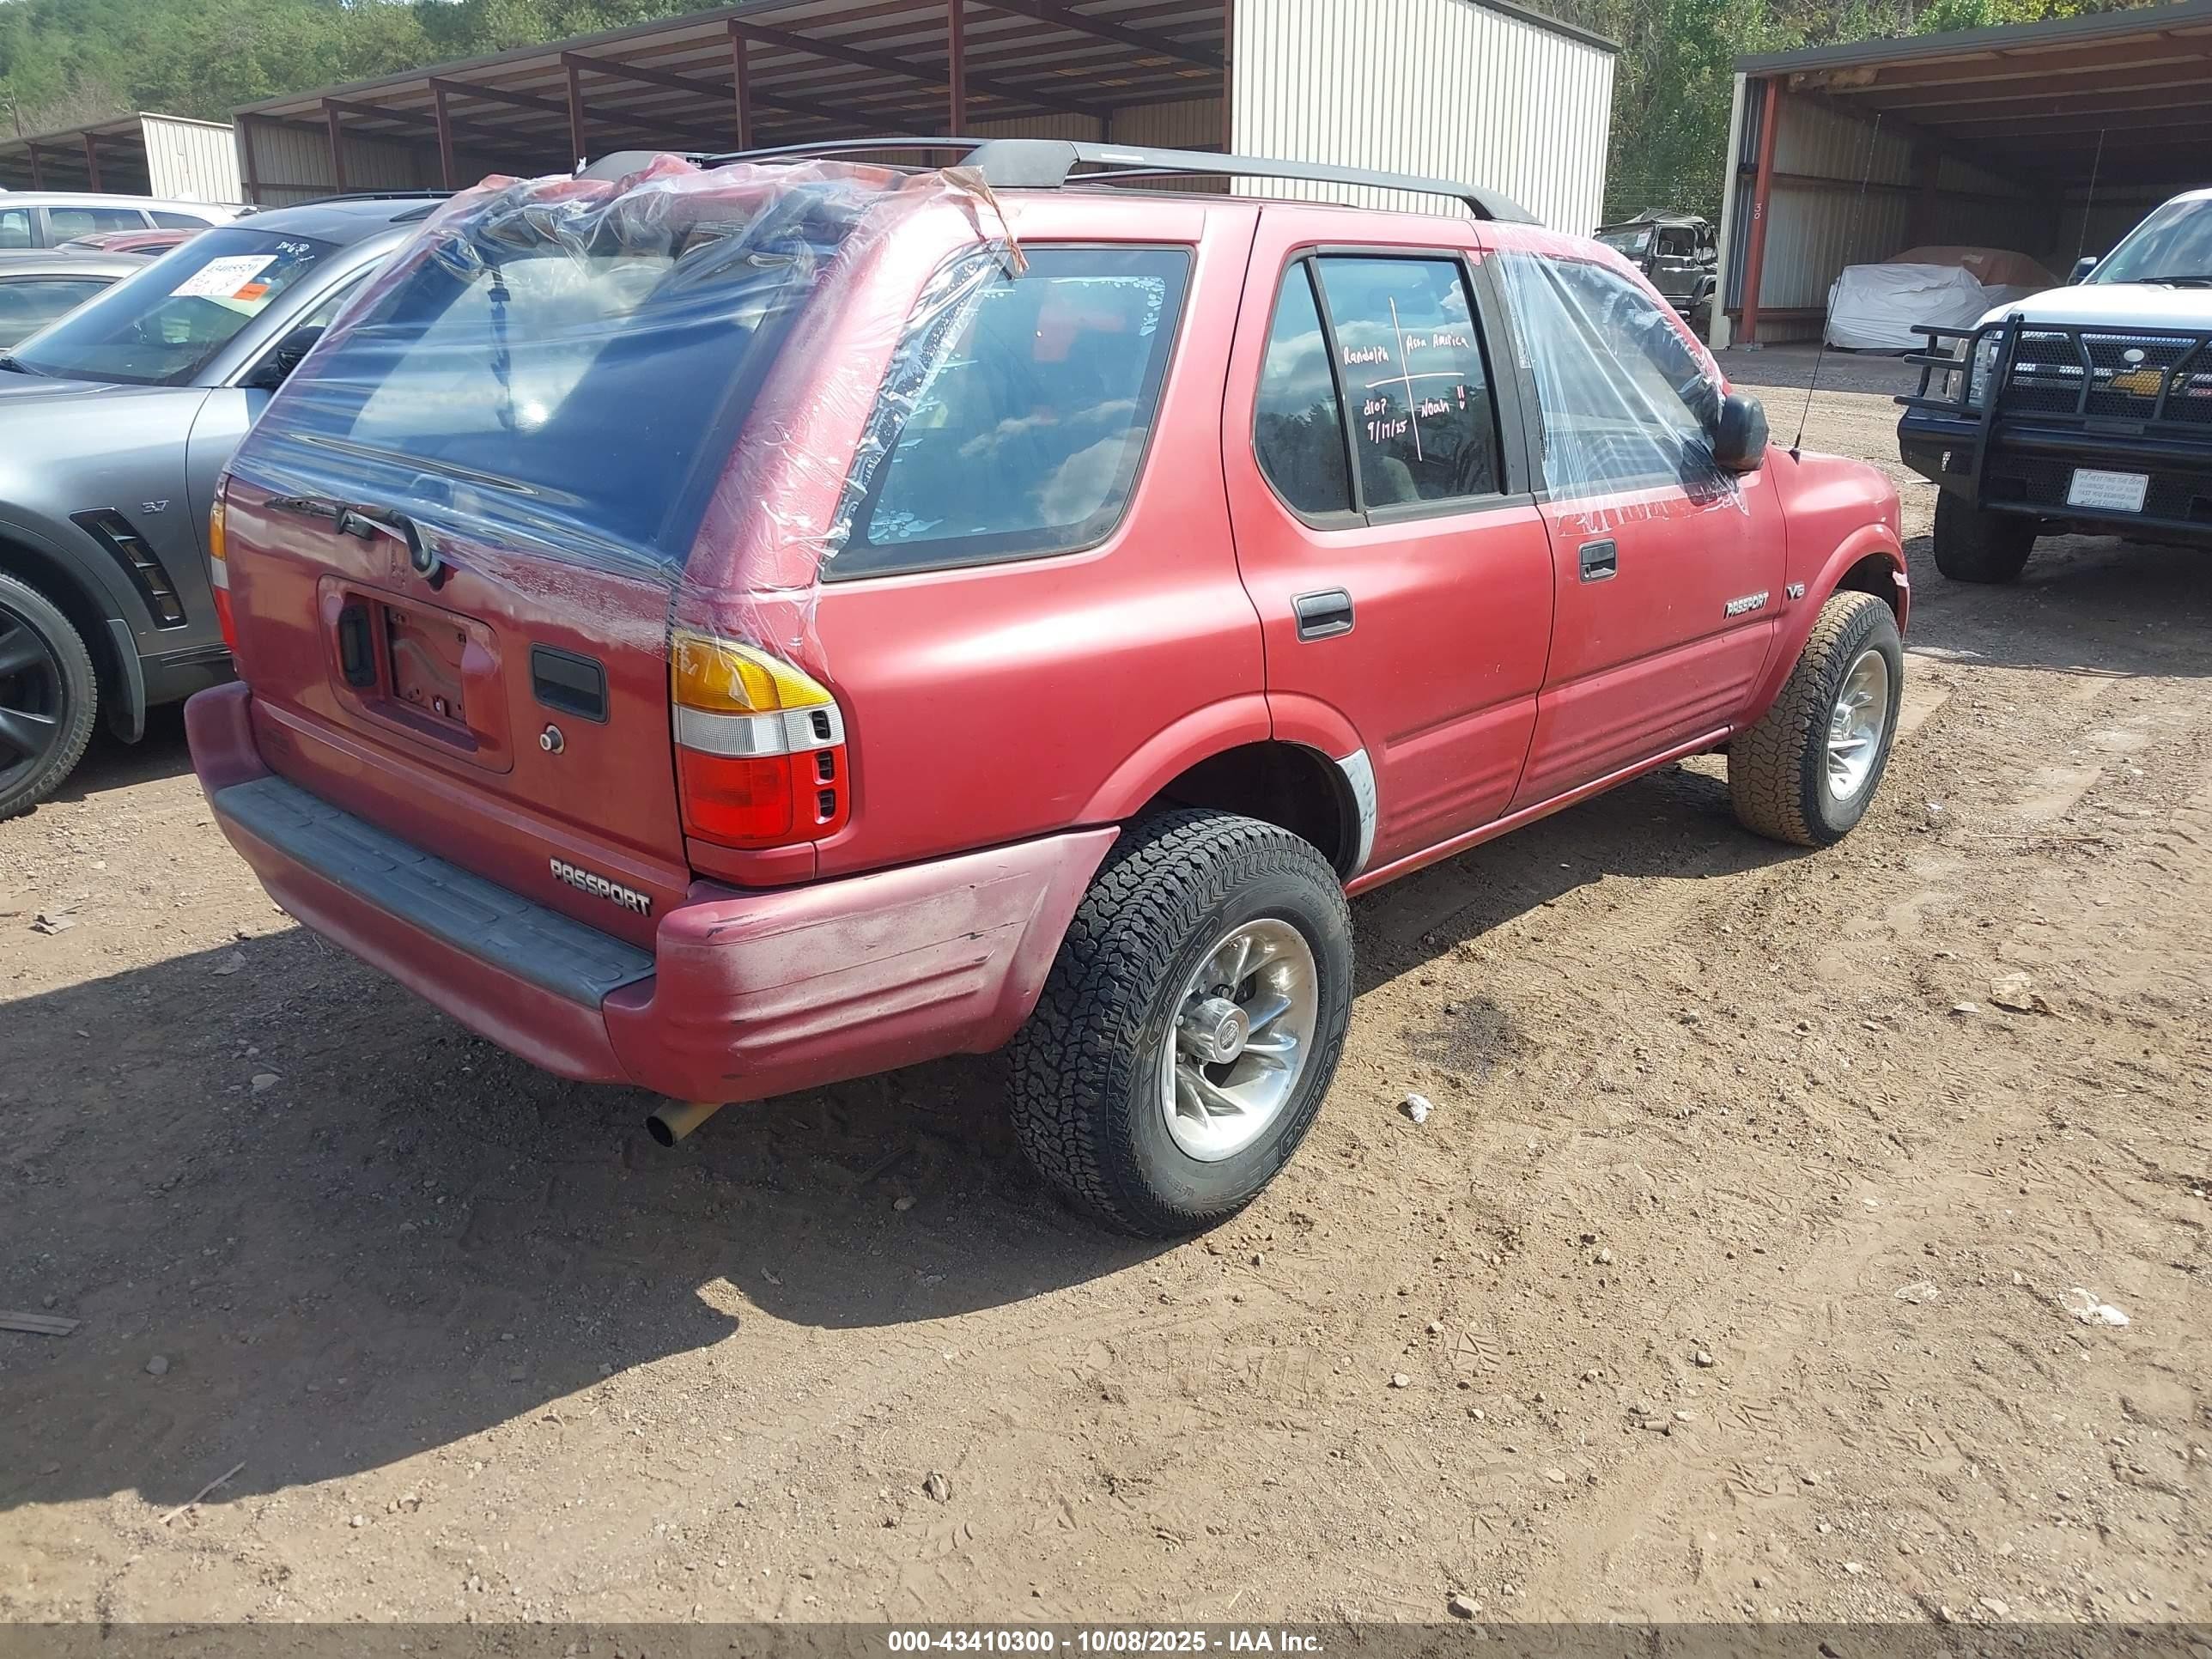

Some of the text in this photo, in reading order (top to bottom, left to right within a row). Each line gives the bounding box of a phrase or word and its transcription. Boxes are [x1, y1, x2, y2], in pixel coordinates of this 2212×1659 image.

[1421, 398, 1450, 418] Noah
[1787, 582, 1805, 600] V6
[1724, 591, 1769, 618] PASSPORT
[549, 856, 653, 918] PASSPORT
